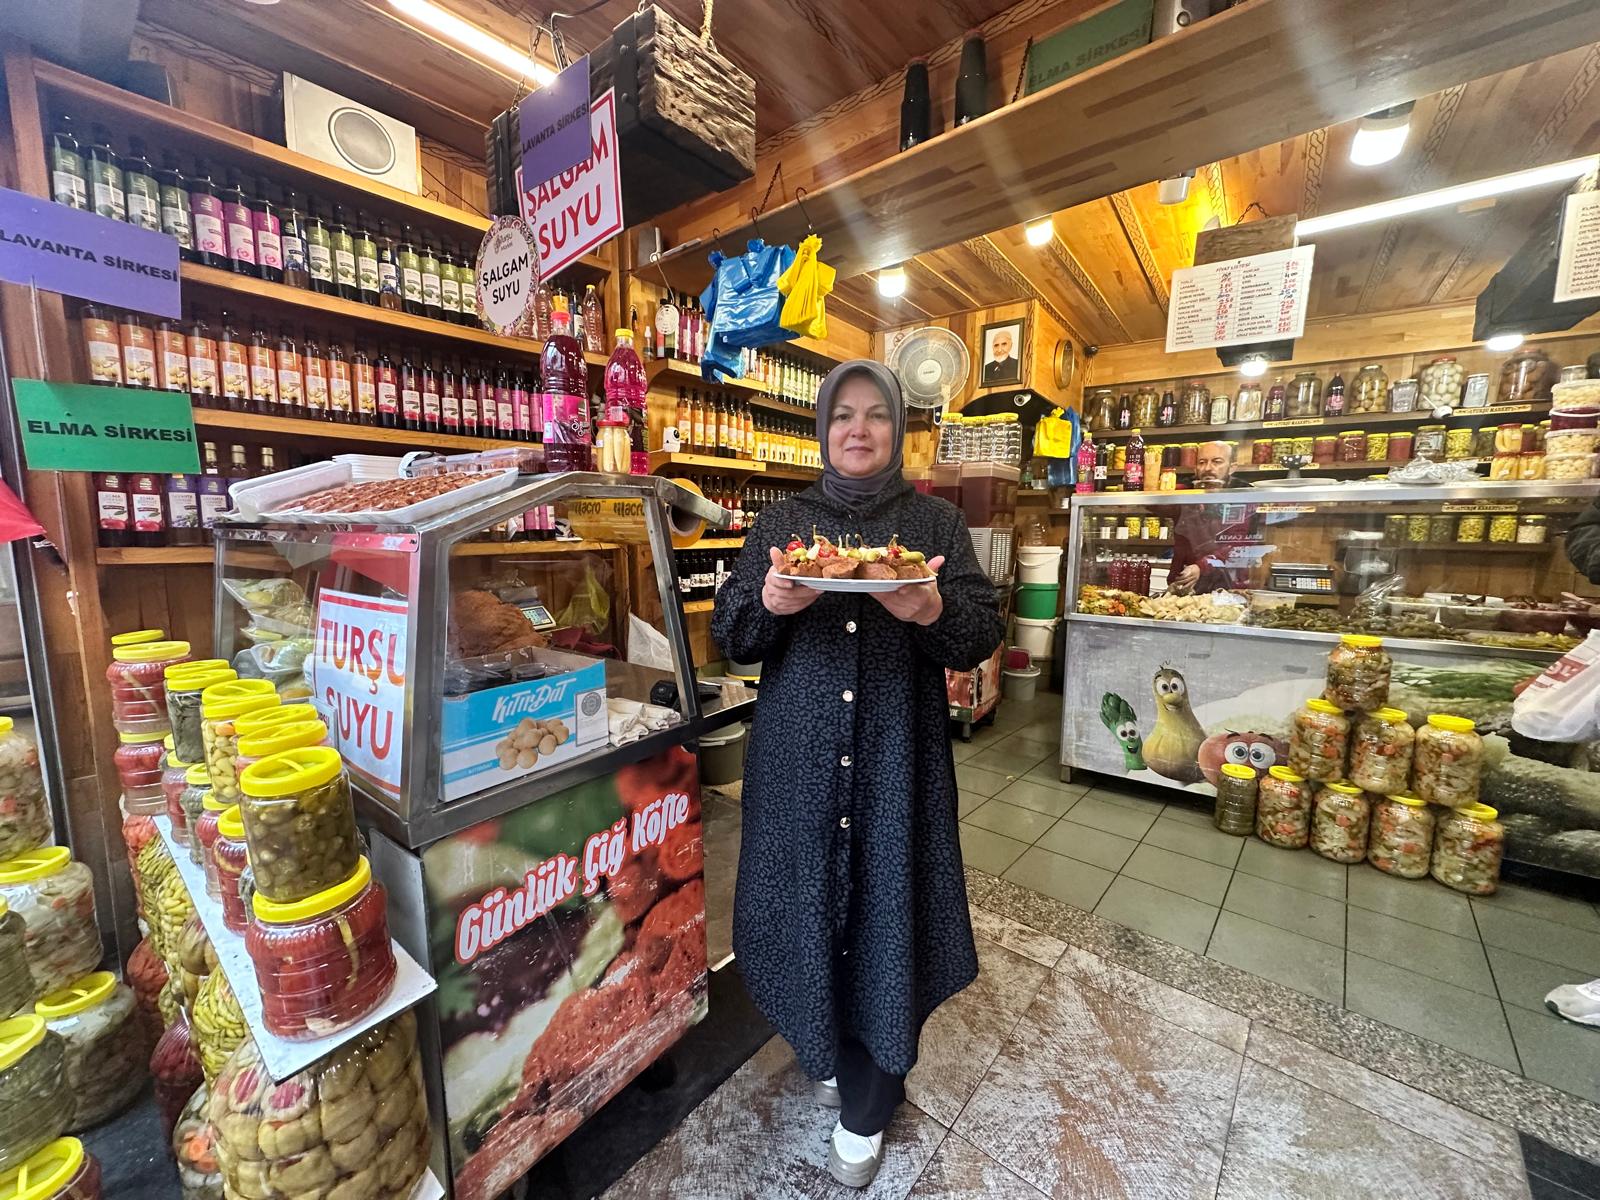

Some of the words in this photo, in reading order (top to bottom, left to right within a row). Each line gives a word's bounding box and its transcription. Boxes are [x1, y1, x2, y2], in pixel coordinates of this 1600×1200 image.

[1029, 60, 1070, 88] ELMA
[1076, 23, 1148, 66] SİRKESİ
[522, 125, 556, 155] LAVANTA
[557, 101, 590, 134] SİRKESİ
[538, 184, 603, 261] SUYU
[0, 229, 97, 264] LAVANTA
[103, 254, 177, 282] SİRKESİ
[482, 252, 528, 291] ŞALGAM
[492, 279, 520, 305] SUYU
[27, 419, 98, 437] ELMA
[104, 423, 193, 442] SİRKESİ
[458, 855, 578, 962] Günlük
[582, 817, 627, 895] Çiğ
[632, 792, 690, 853] Köfte
